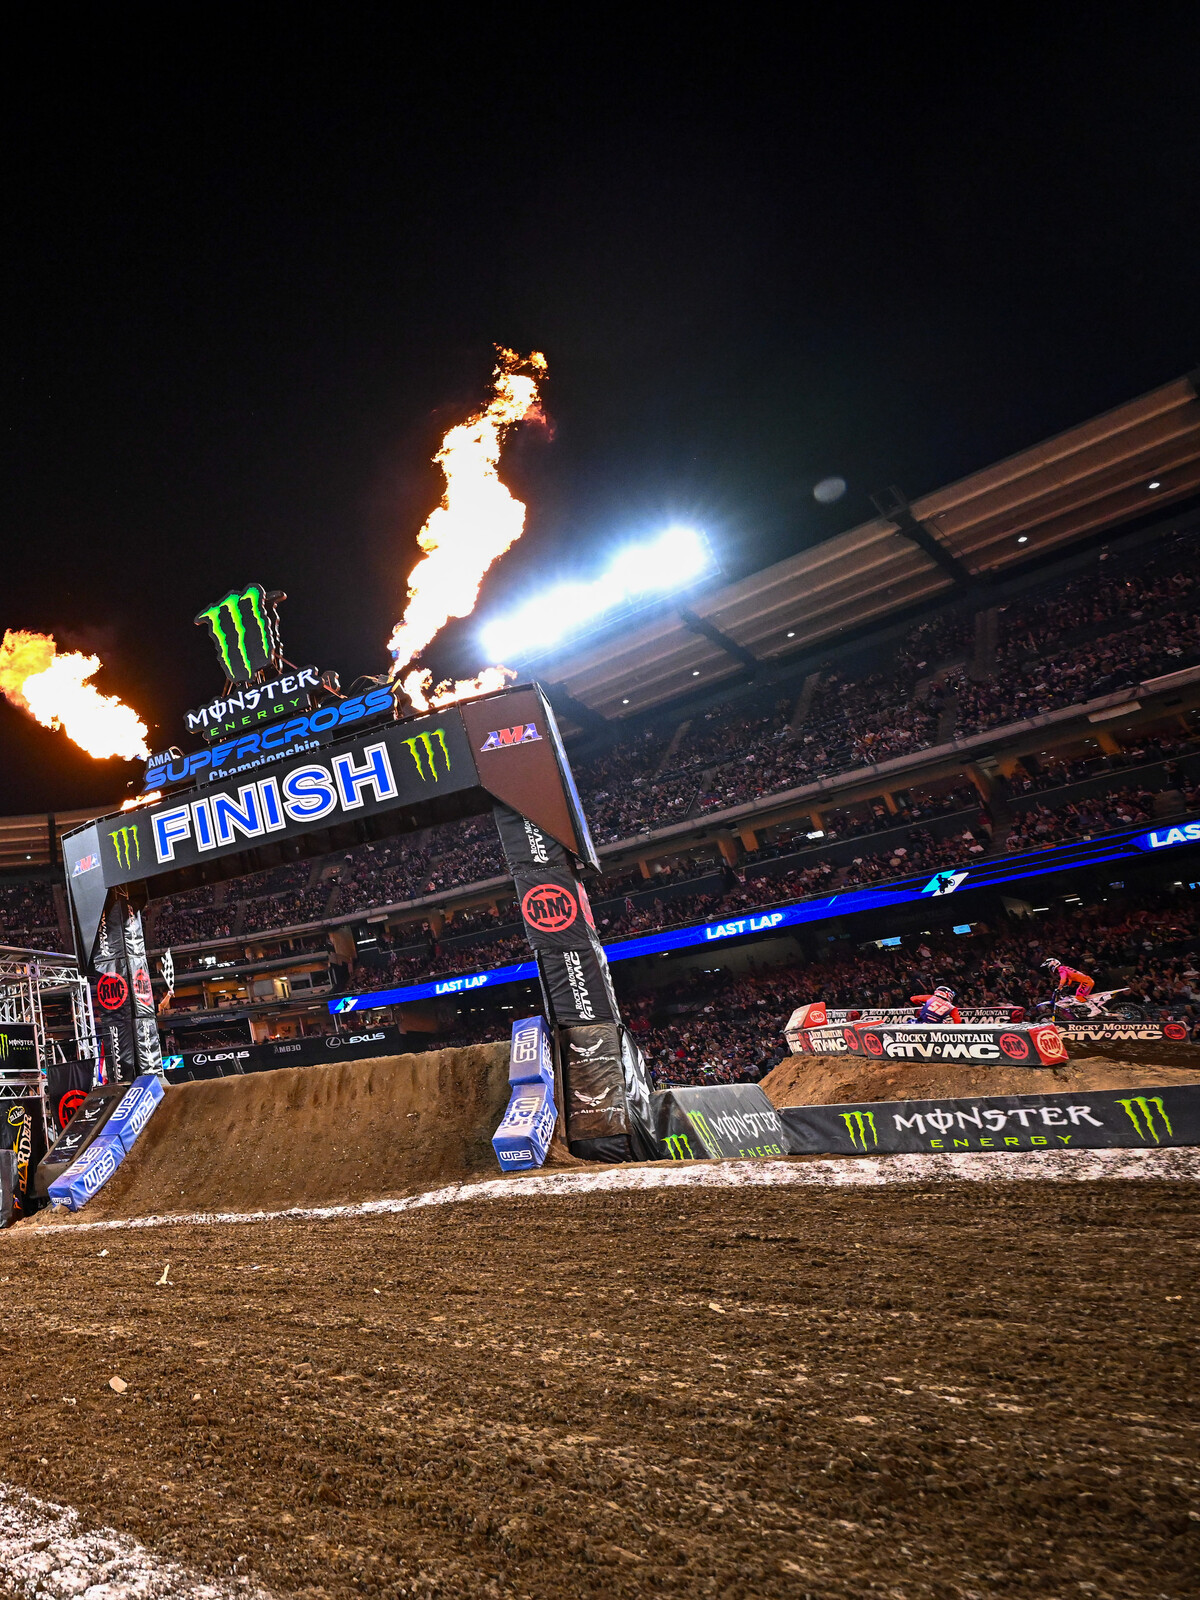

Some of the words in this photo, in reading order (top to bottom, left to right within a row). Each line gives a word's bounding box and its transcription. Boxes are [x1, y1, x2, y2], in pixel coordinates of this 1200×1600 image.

[187, 668, 320, 729] MONSTER
[210, 698, 300, 737] ENERGY
[144, 685, 394, 791] SUPERCROSS
[480, 723, 543, 750] AMA
[148, 752, 171, 769] AMA
[209, 739, 320, 782] Championship
[151, 741, 398, 864] FINISH
[1150, 823, 1200, 848] LAS
[706, 920, 746, 939] LAST
[750, 913, 783, 930] LAP
[563, 951, 577, 987] MOUNTAIN
[436, 979, 463, 994] LAST
[465, 975, 487, 991] LAP
[572, 987, 583, 1010] ROCKY
[342, 1032, 386, 1044] LEXUS
[895, 1032, 927, 1042] ROCKY
[930, 1032, 994, 1042] MOUNTAIN
[208, 1051, 250, 1062] LEXUS
[709, 1109, 781, 1143] MONSTER
[892, 1105, 1104, 1135] MONSTER
[739, 1144, 781, 1158] ENERG
[930, 1135, 1072, 1148] ENERGY
[499, 1150, 532, 1161] WPS
